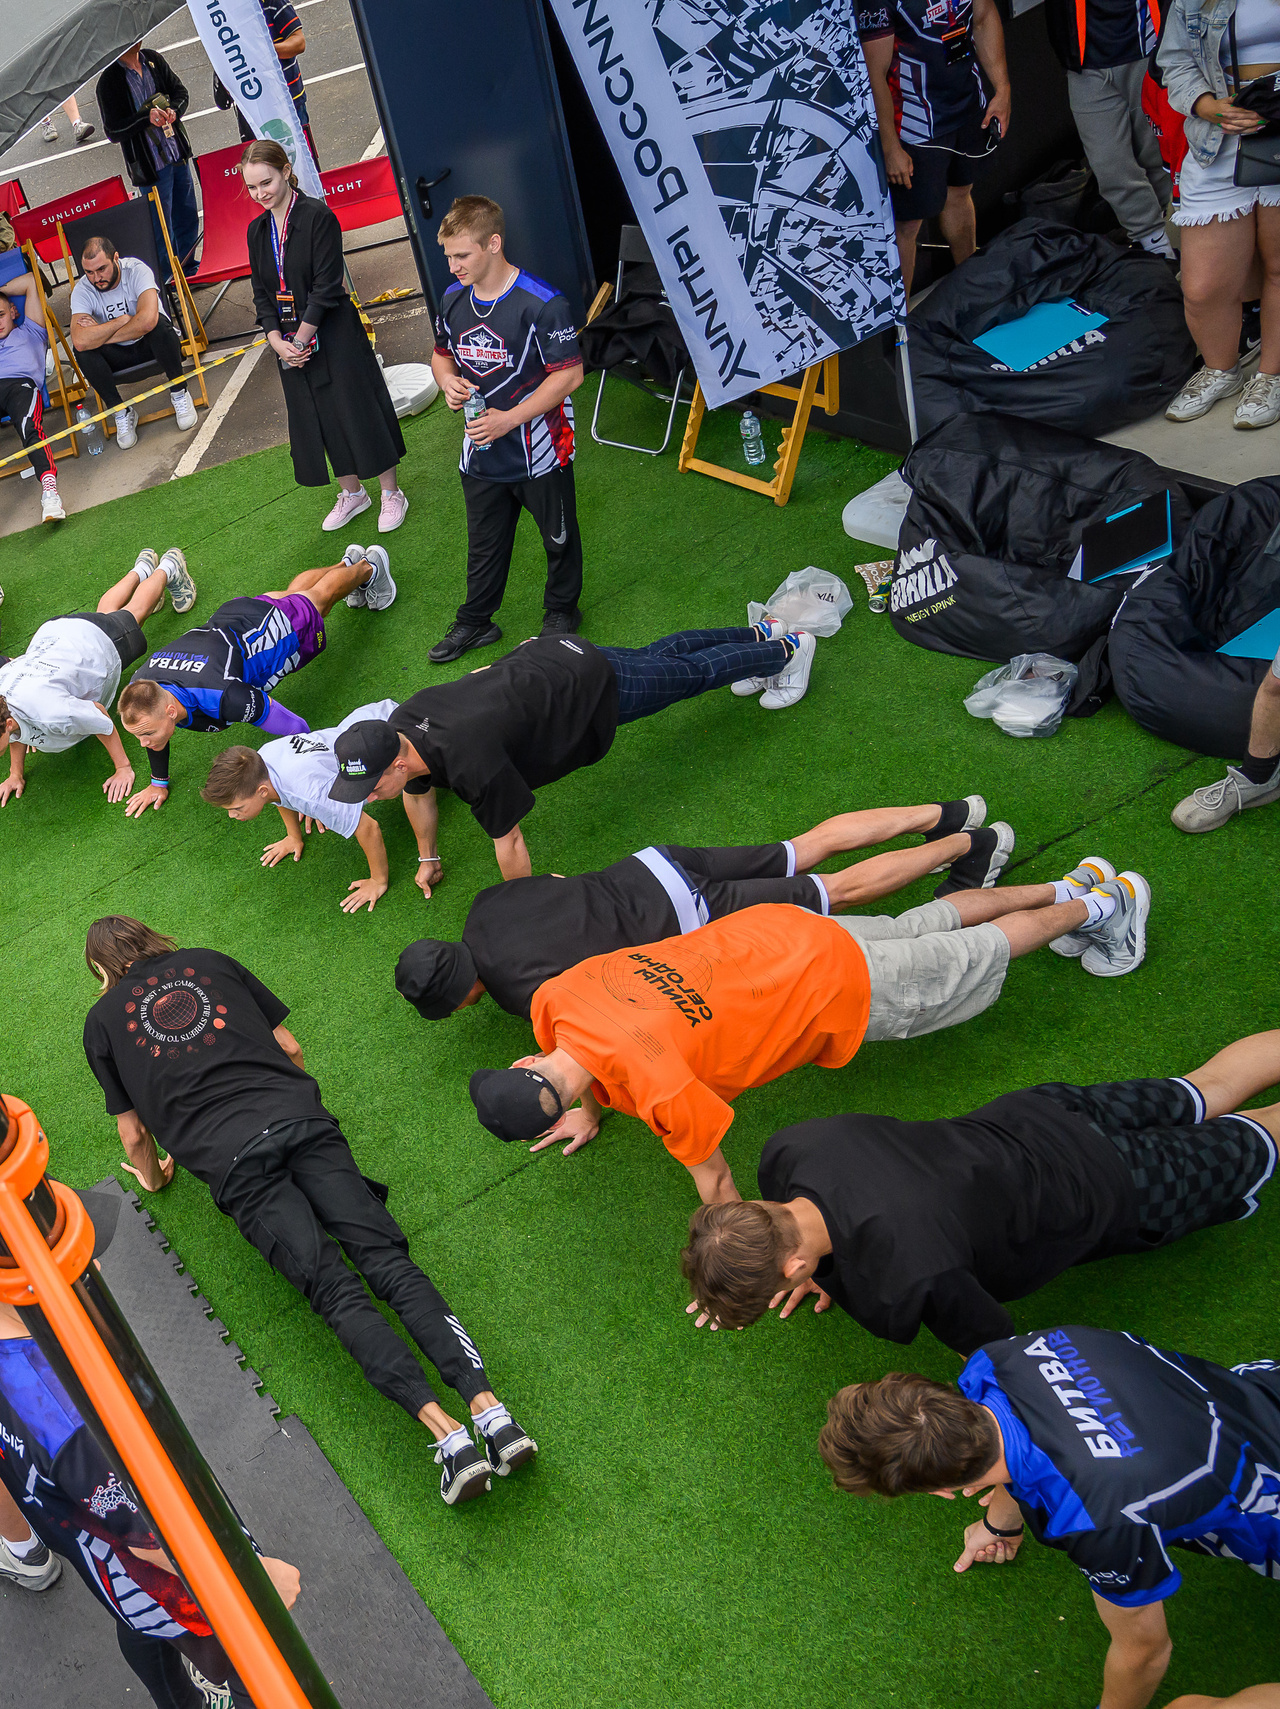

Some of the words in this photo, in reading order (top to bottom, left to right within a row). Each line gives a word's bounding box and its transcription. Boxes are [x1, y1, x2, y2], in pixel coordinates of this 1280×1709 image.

[325, 179, 363, 197] LIGHT
[41, 199, 97, 226] SUNLIGHT
[932, 594, 957, 615] DRINK
[149, 657, 207, 674] БИТВА
[627, 953, 713, 1021] СЕГОДНЯ
[634, 968, 701, 1028] УЛИЦЫ
[167, 1035, 180, 1043] TO
[180, 1017, 208, 1041] STREETS
[1023, 1336, 1123, 1459] БИТВА
